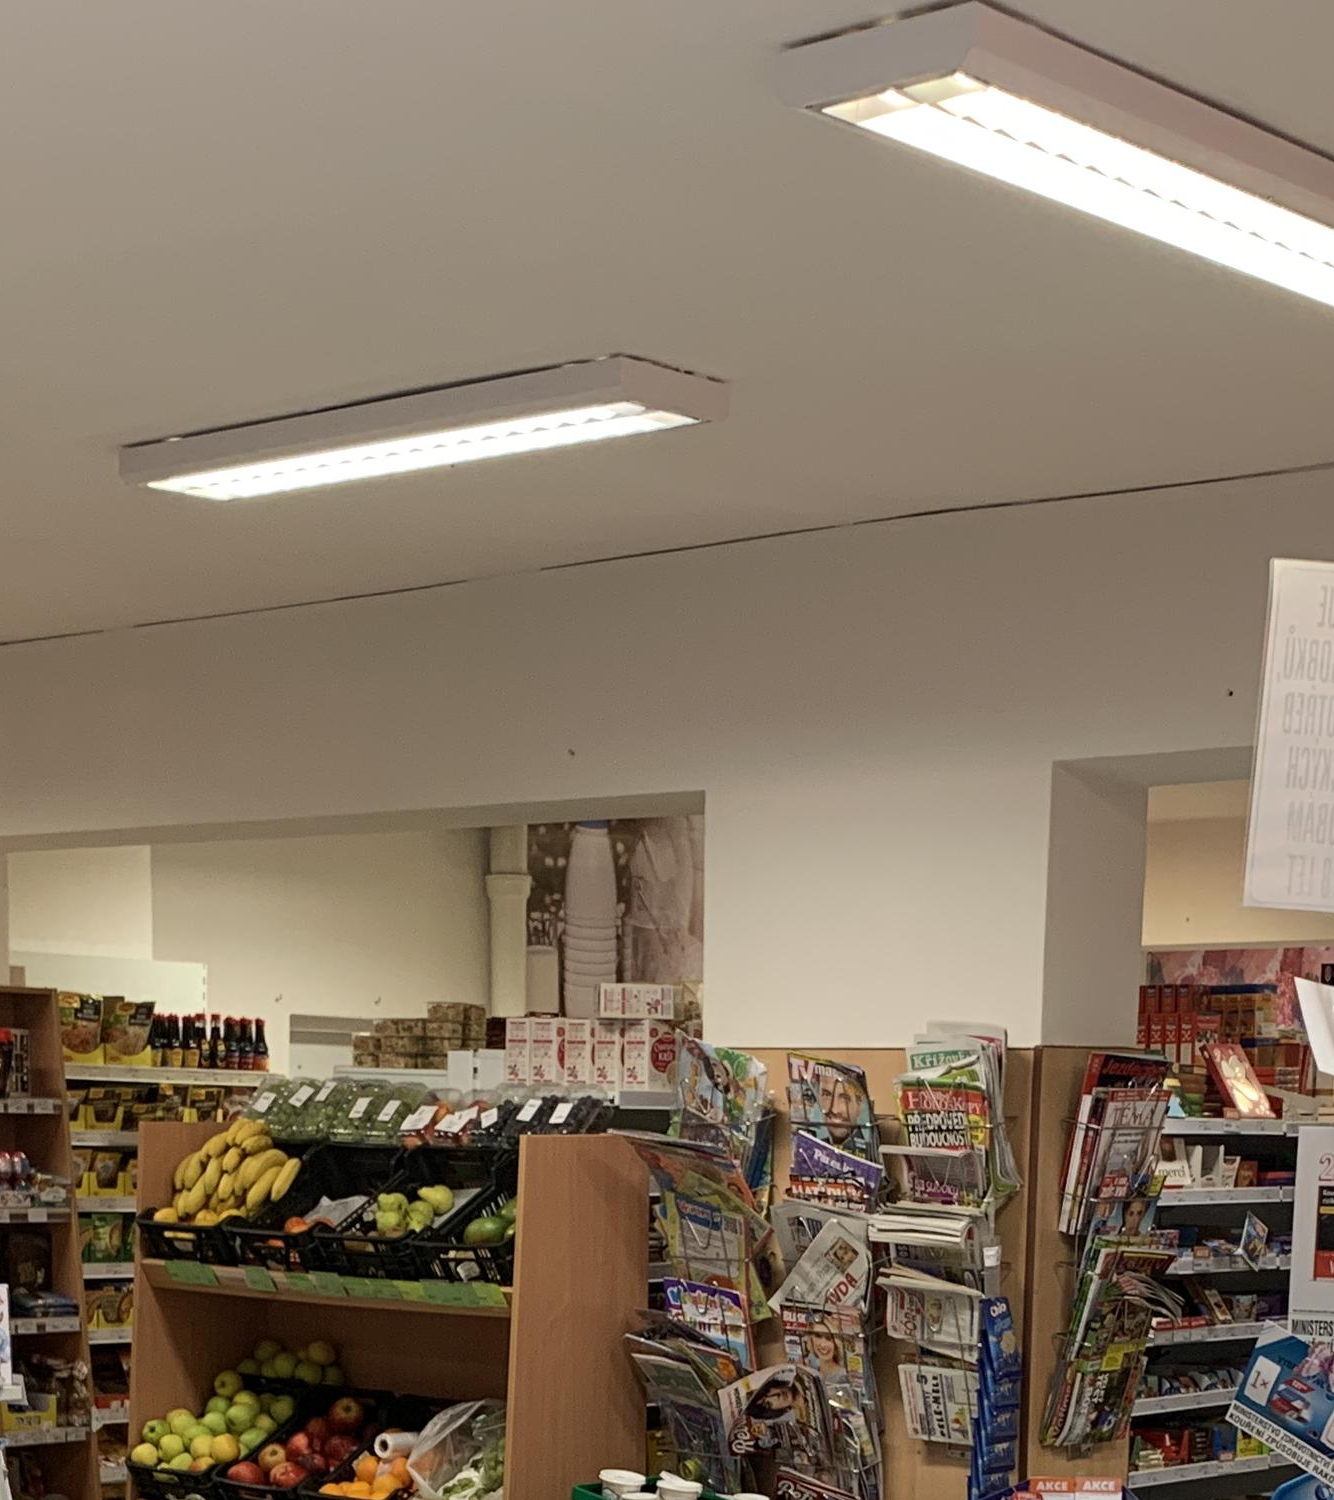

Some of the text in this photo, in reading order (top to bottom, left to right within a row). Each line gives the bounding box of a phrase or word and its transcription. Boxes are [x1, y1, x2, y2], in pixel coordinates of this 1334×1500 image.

[1228, 1412, 1265, 1440] KOUŘENÍ
[1265, 1434, 1311, 1468] ZPŮSOBUJE
[1233, 1403, 1282, 1438] MINISTERSTVO
[1281, 1433, 1331, 1467] ZDRAVOTNICTVÍ
[1036, 1481, 1068, 1491] AKCE
[1082, 1481, 1115, 1491] AKCE
